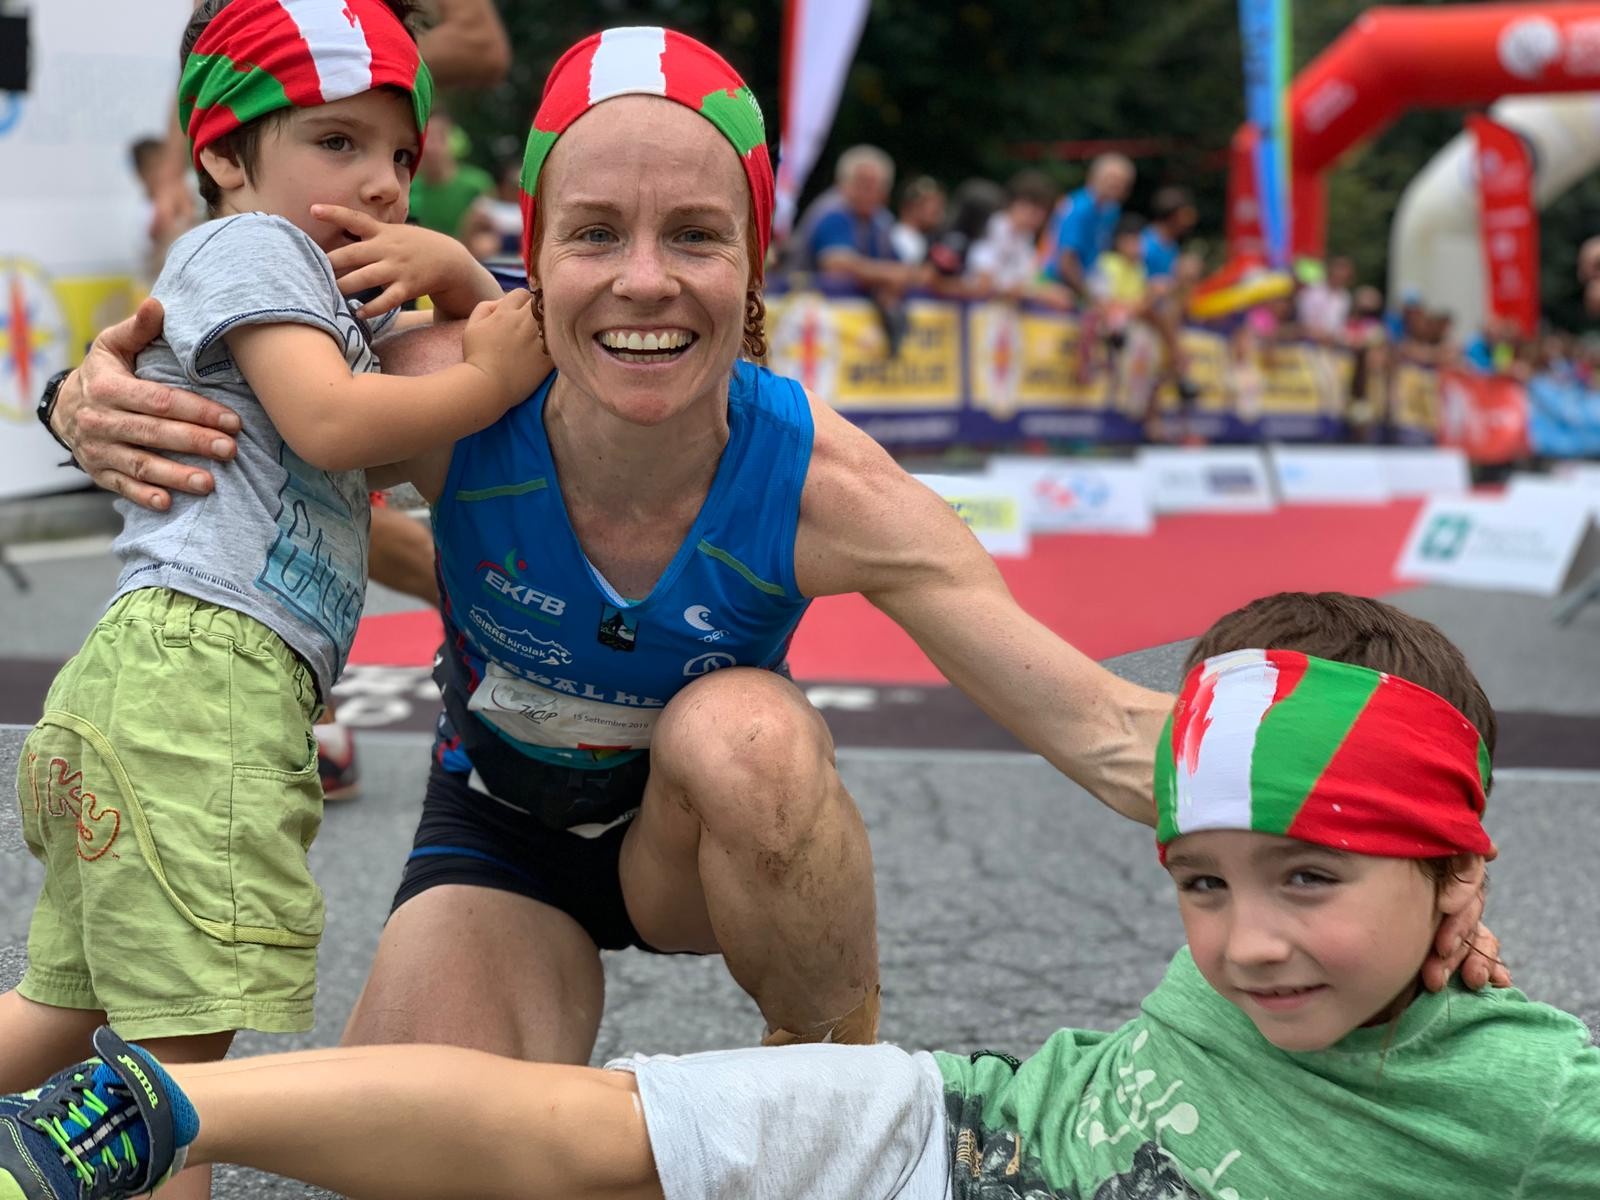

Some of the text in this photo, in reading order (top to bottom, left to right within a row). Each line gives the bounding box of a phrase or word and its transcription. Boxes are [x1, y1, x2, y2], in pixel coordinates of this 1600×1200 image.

[484, 570, 566, 616] EKFB
[469, 609, 546, 659] AGIRRE kirolak
[573, 713, 583, 721] 15
[584, 714, 628, 729] Settembre
